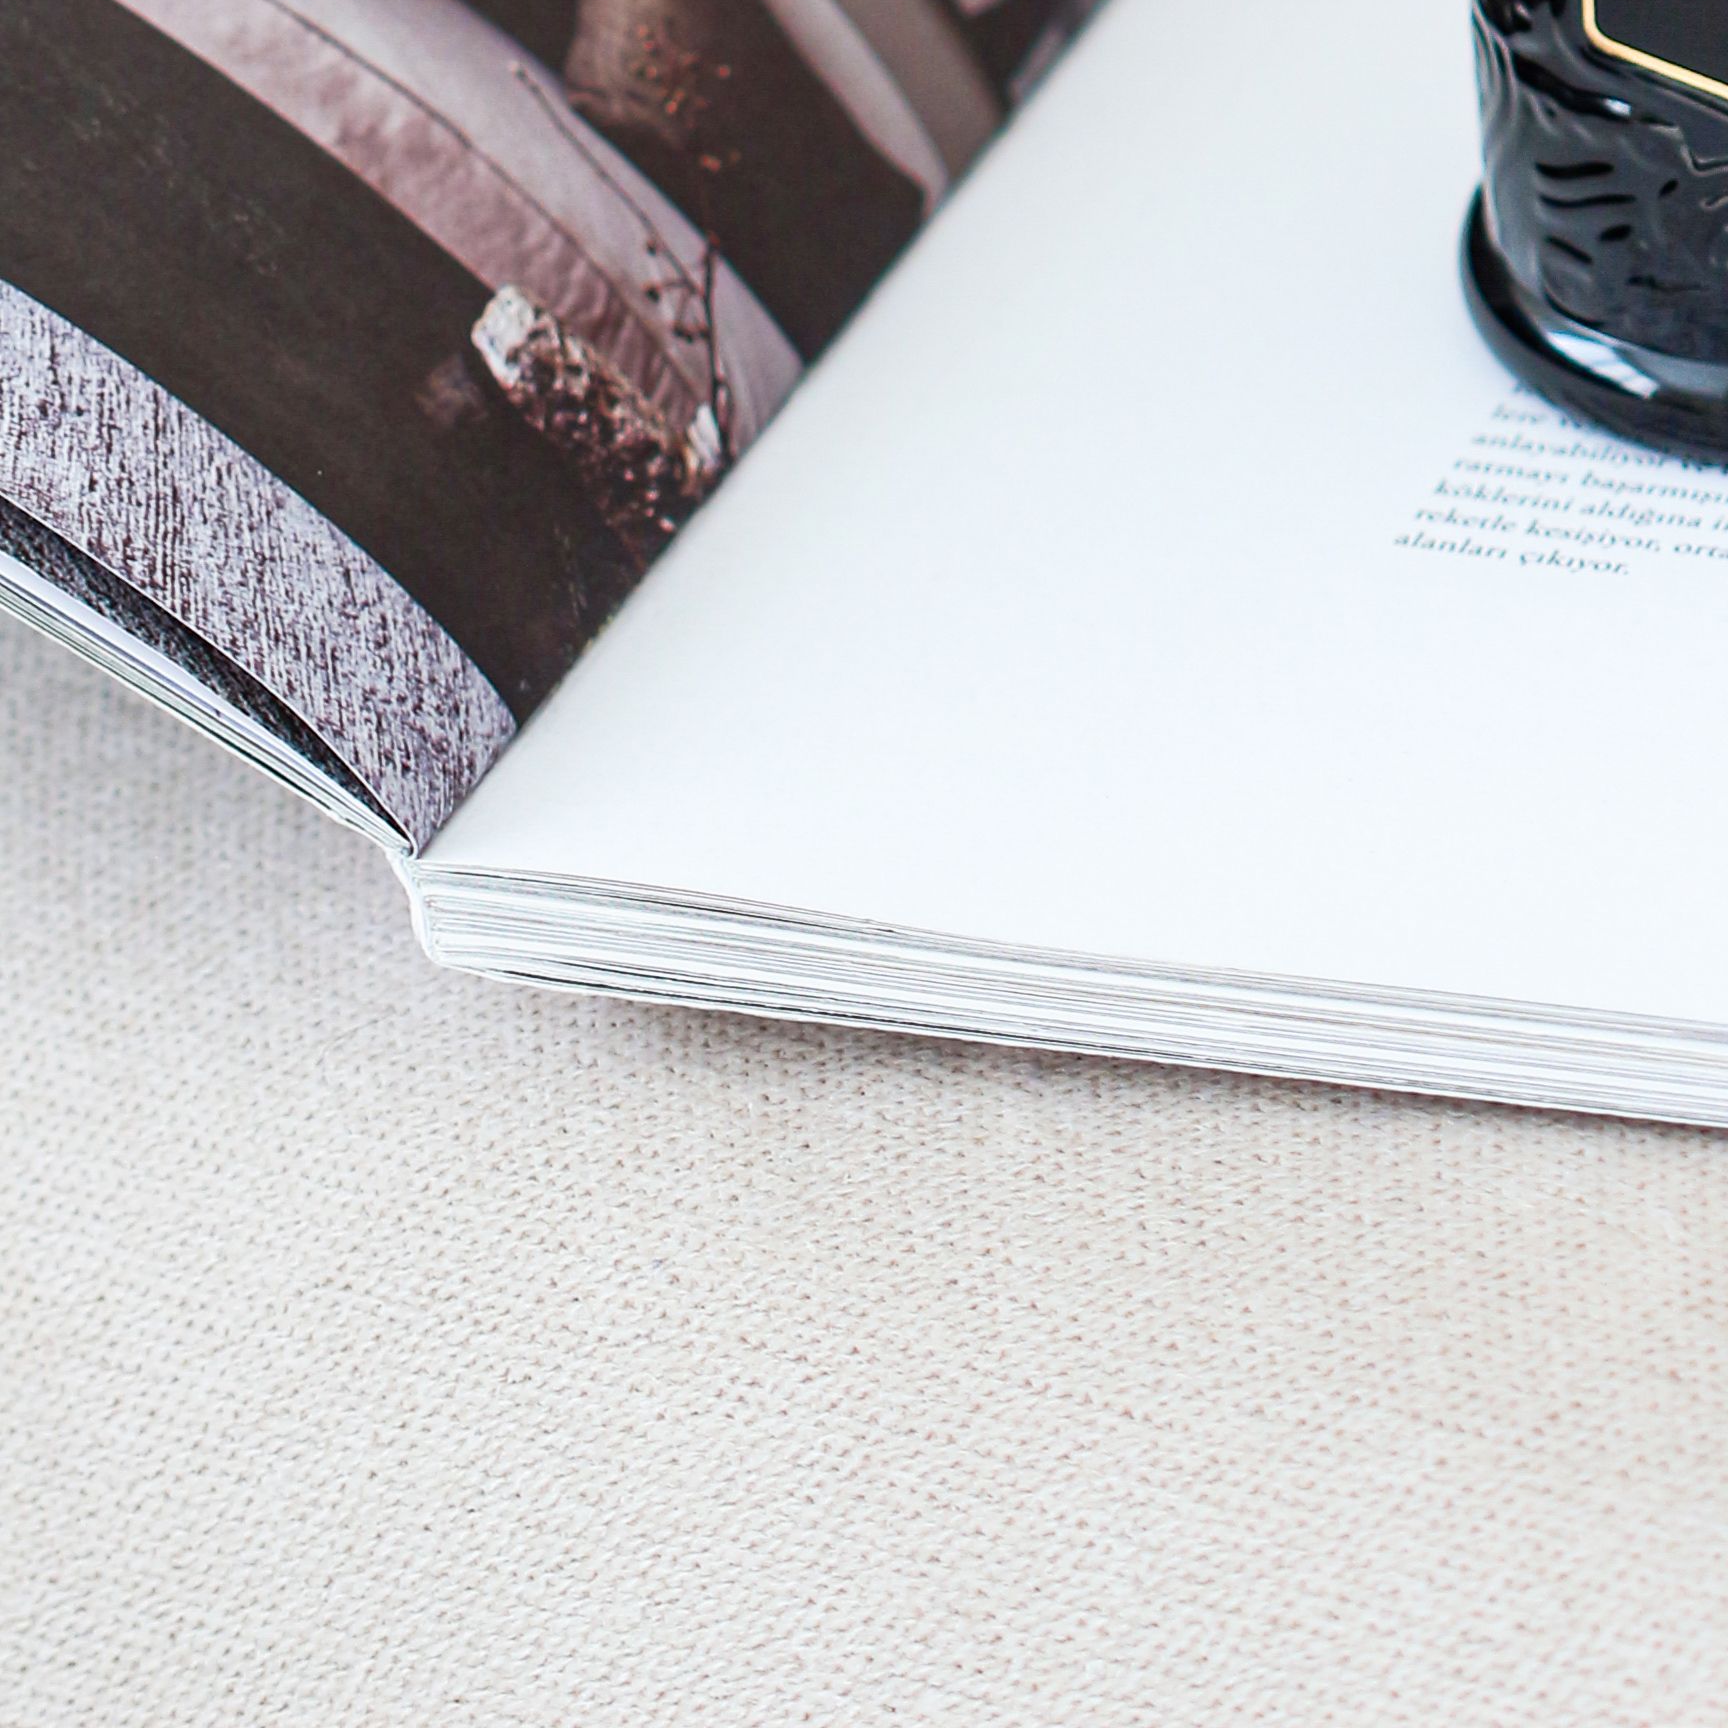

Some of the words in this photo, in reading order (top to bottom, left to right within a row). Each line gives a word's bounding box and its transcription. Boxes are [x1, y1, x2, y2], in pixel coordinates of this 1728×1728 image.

[1415, 508, 1518, 534] reketle
[1395, 532, 1508, 560] alanları
[1520, 550, 1629, 576] çıkıyor.
